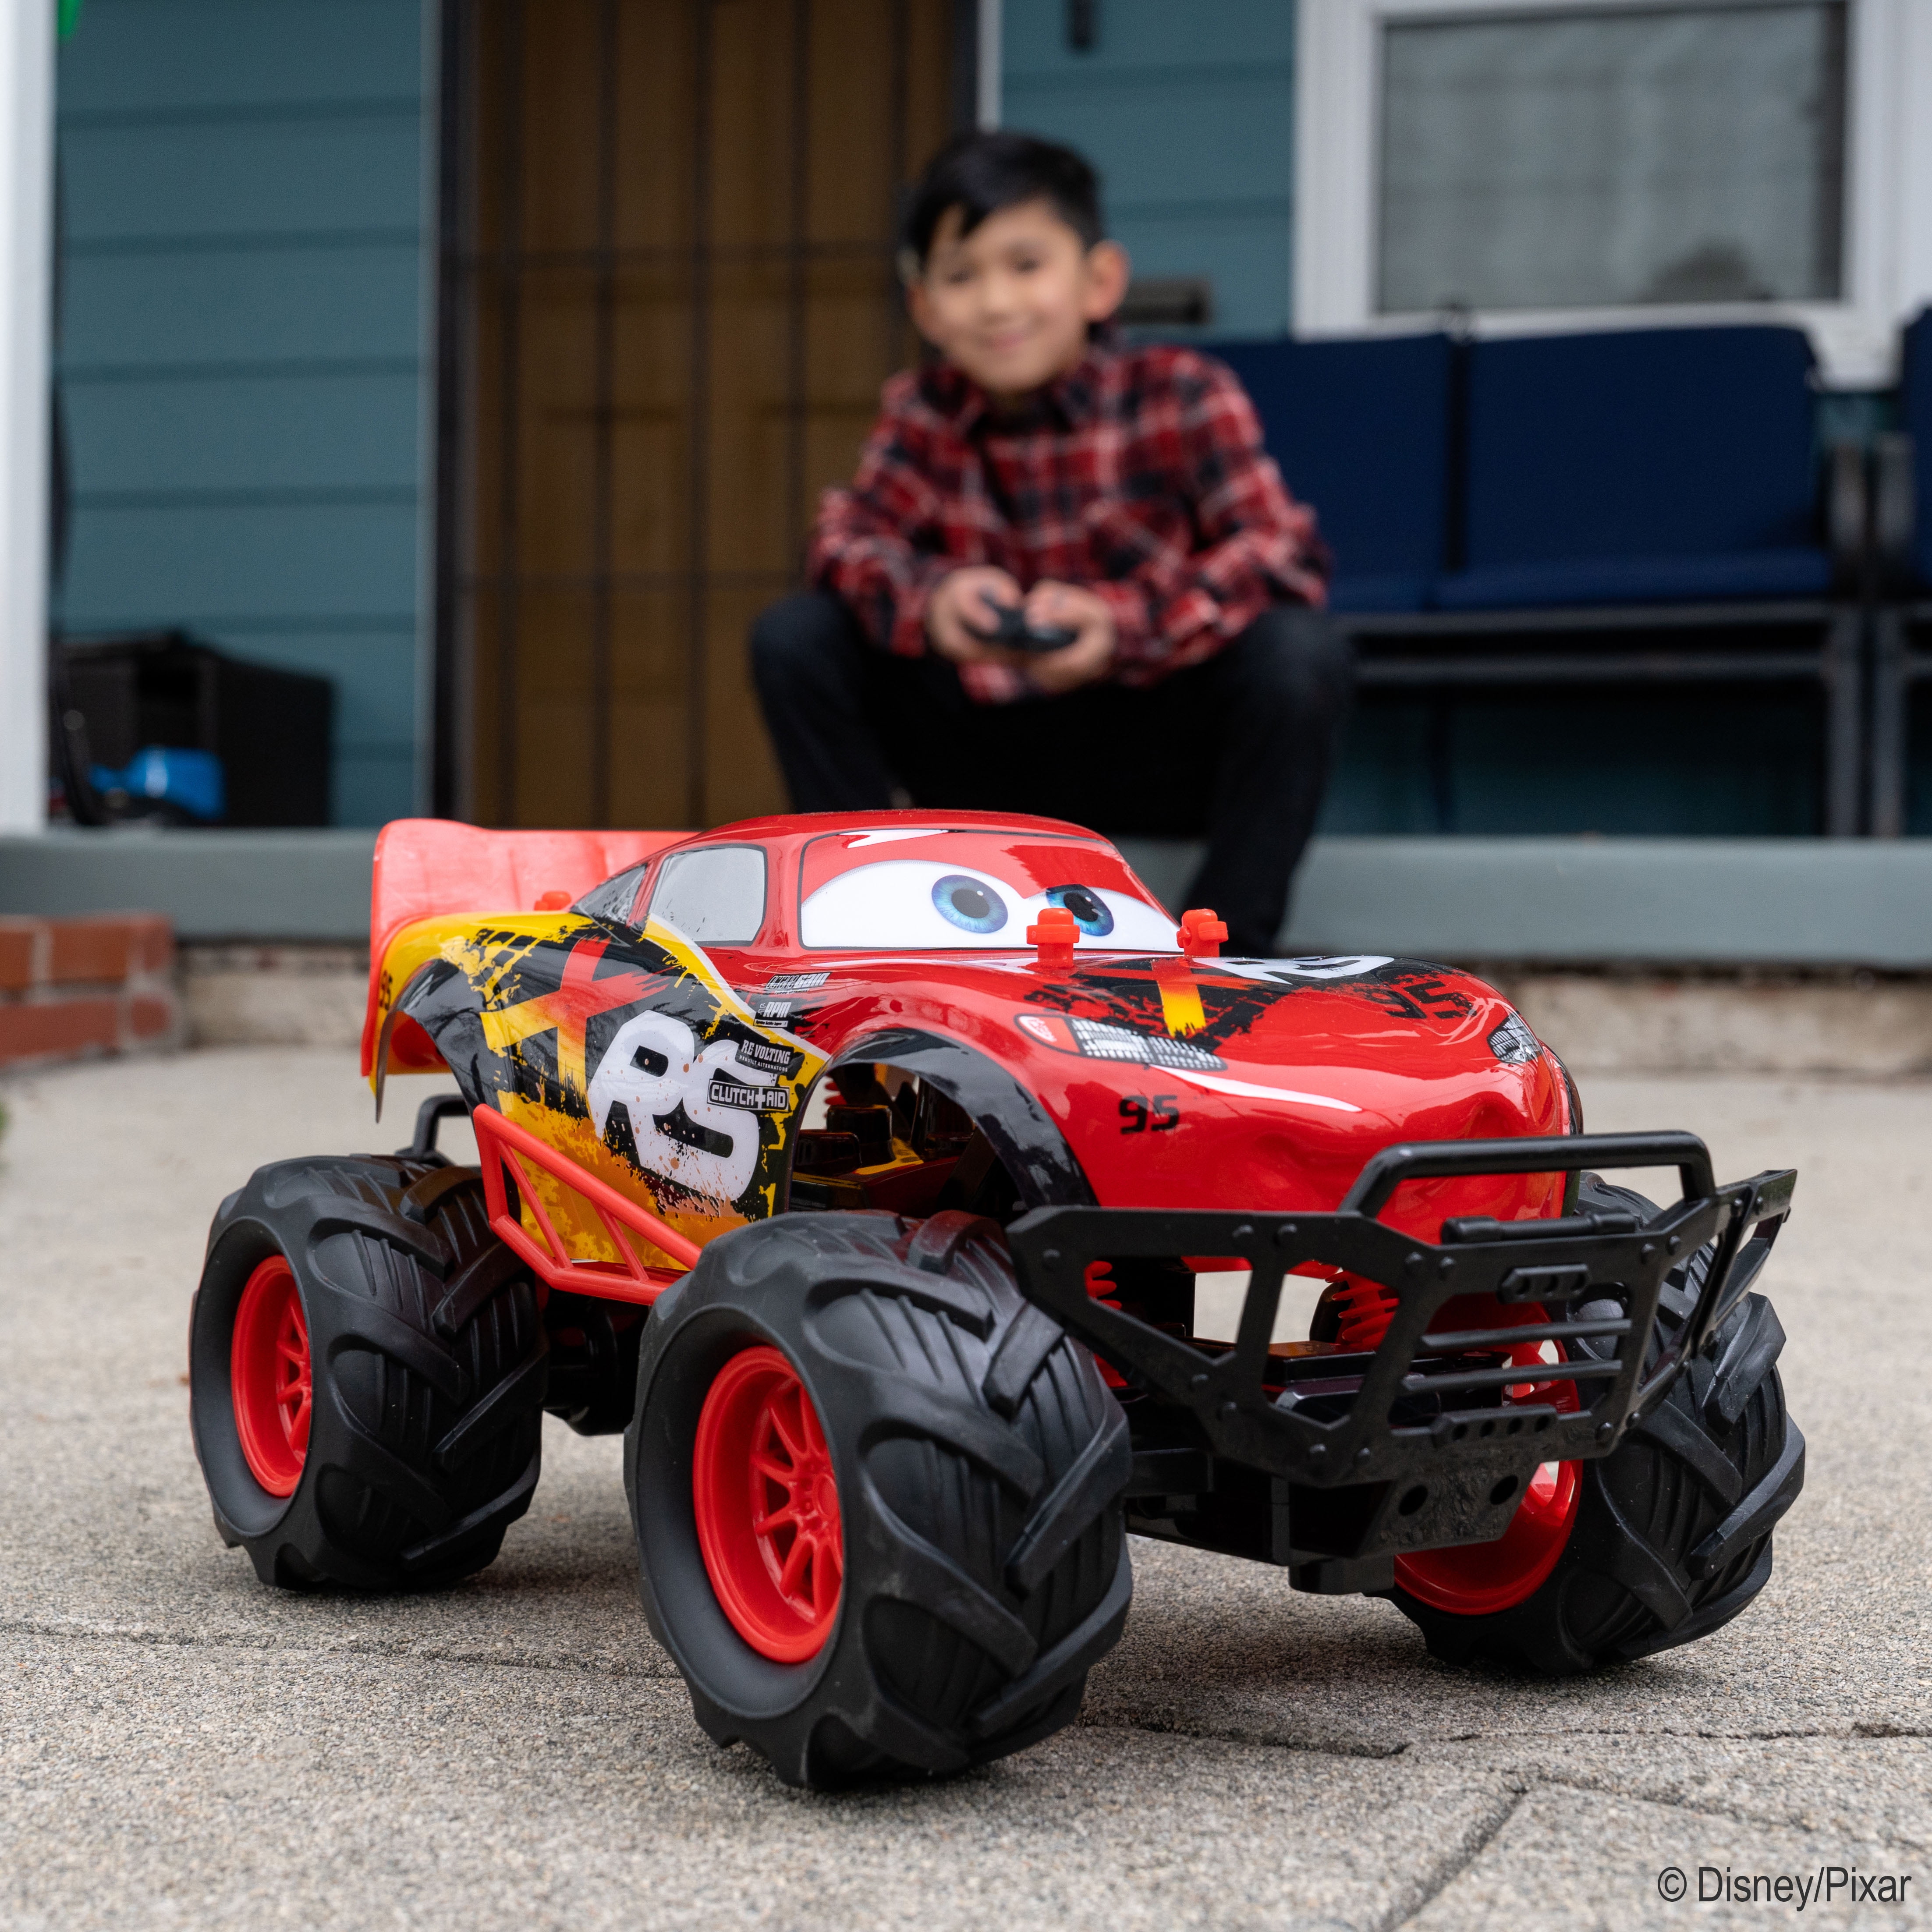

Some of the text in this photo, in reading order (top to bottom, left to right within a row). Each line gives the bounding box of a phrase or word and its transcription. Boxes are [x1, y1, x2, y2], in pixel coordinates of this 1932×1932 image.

[762, 1001, 792, 1018] RPM
[739, 1055, 788, 1072] REBUILT ALTERNATORS
[755, 1044, 791, 1064] VOLTING
[711, 1084, 786, 1108] CLUTCH AID
[1119, 1095, 1180, 1135] 95
